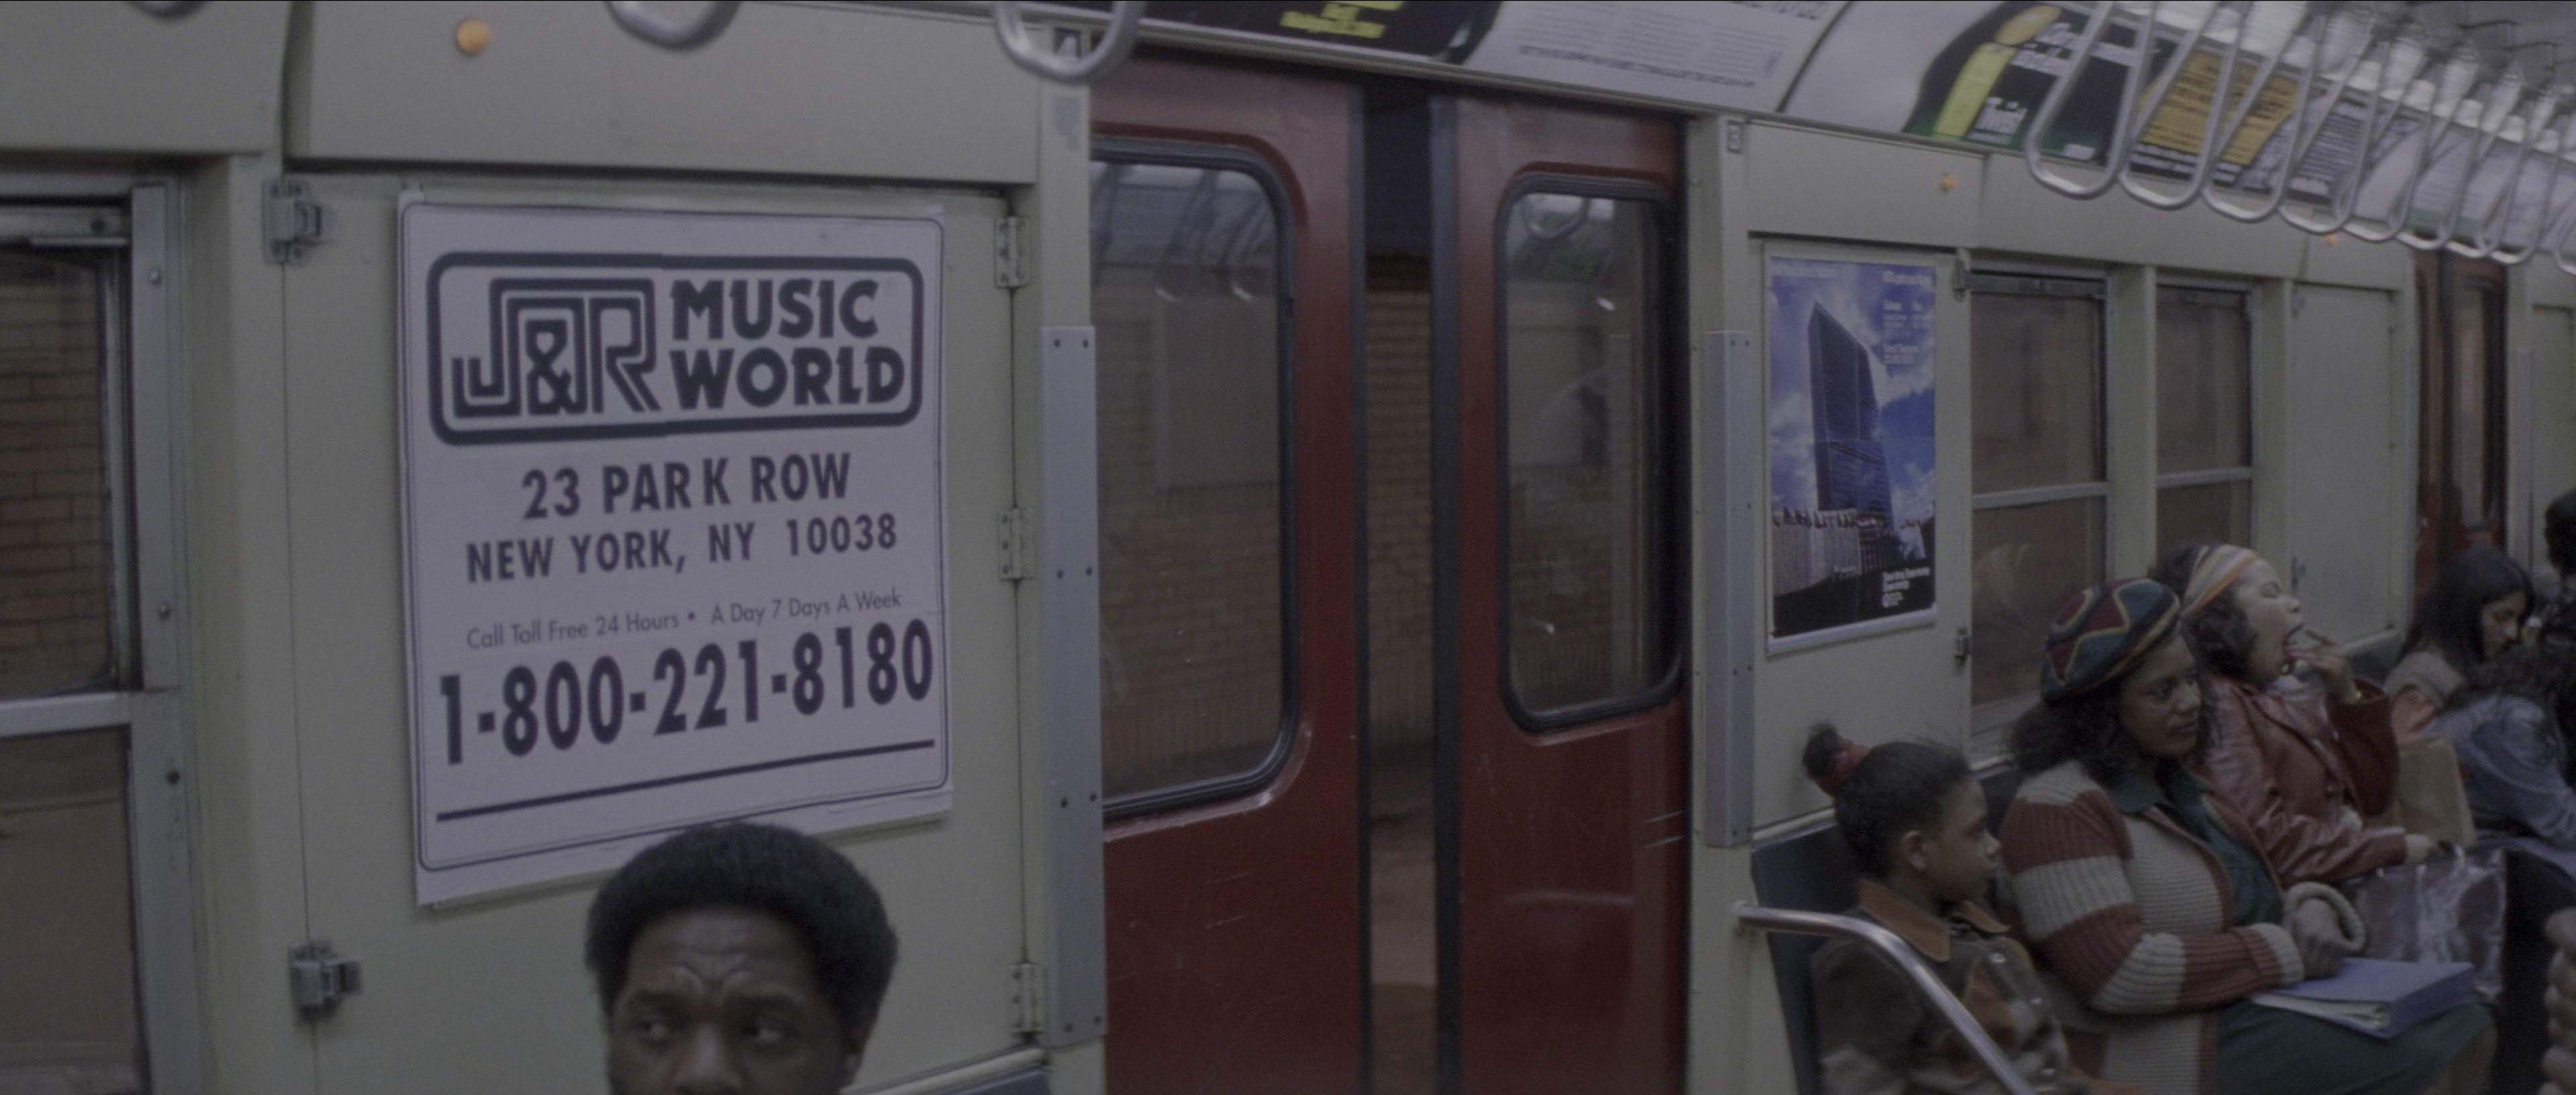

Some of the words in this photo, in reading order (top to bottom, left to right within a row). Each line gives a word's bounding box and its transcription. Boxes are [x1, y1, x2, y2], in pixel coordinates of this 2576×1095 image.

[670, 278, 879, 341] MUSIC
[451, 277, 661, 419] J&R
[669, 346, 905, 410] WORLD
[522, 467, 580, 520] 23
[602, 457, 731, 514] PARK
[750, 452, 851, 503] ROW
[467, 537, 553, 583] NEW
[570, 529, 686, 574] YORK,
[708, 522, 755, 562] NY
[787, 512, 897, 556] 10038
[466, 623, 504, 649] Call
[511, 619, 541, 645] Toll
[548, 620, 589, 641] Free
[595, 615, 619, 637] 24
[625, 611, 680, 633] Hours
[710, 604, 724, 625] A
[730, 602, 765, 626] Day
[771, 598, 782, 619] 7
[788, 597, 831, 620] Days
[837, 592, 851, 613] A
[854, 586, 902, 611] Week
[440, 619, 933, 766] 1-800-221-8180
